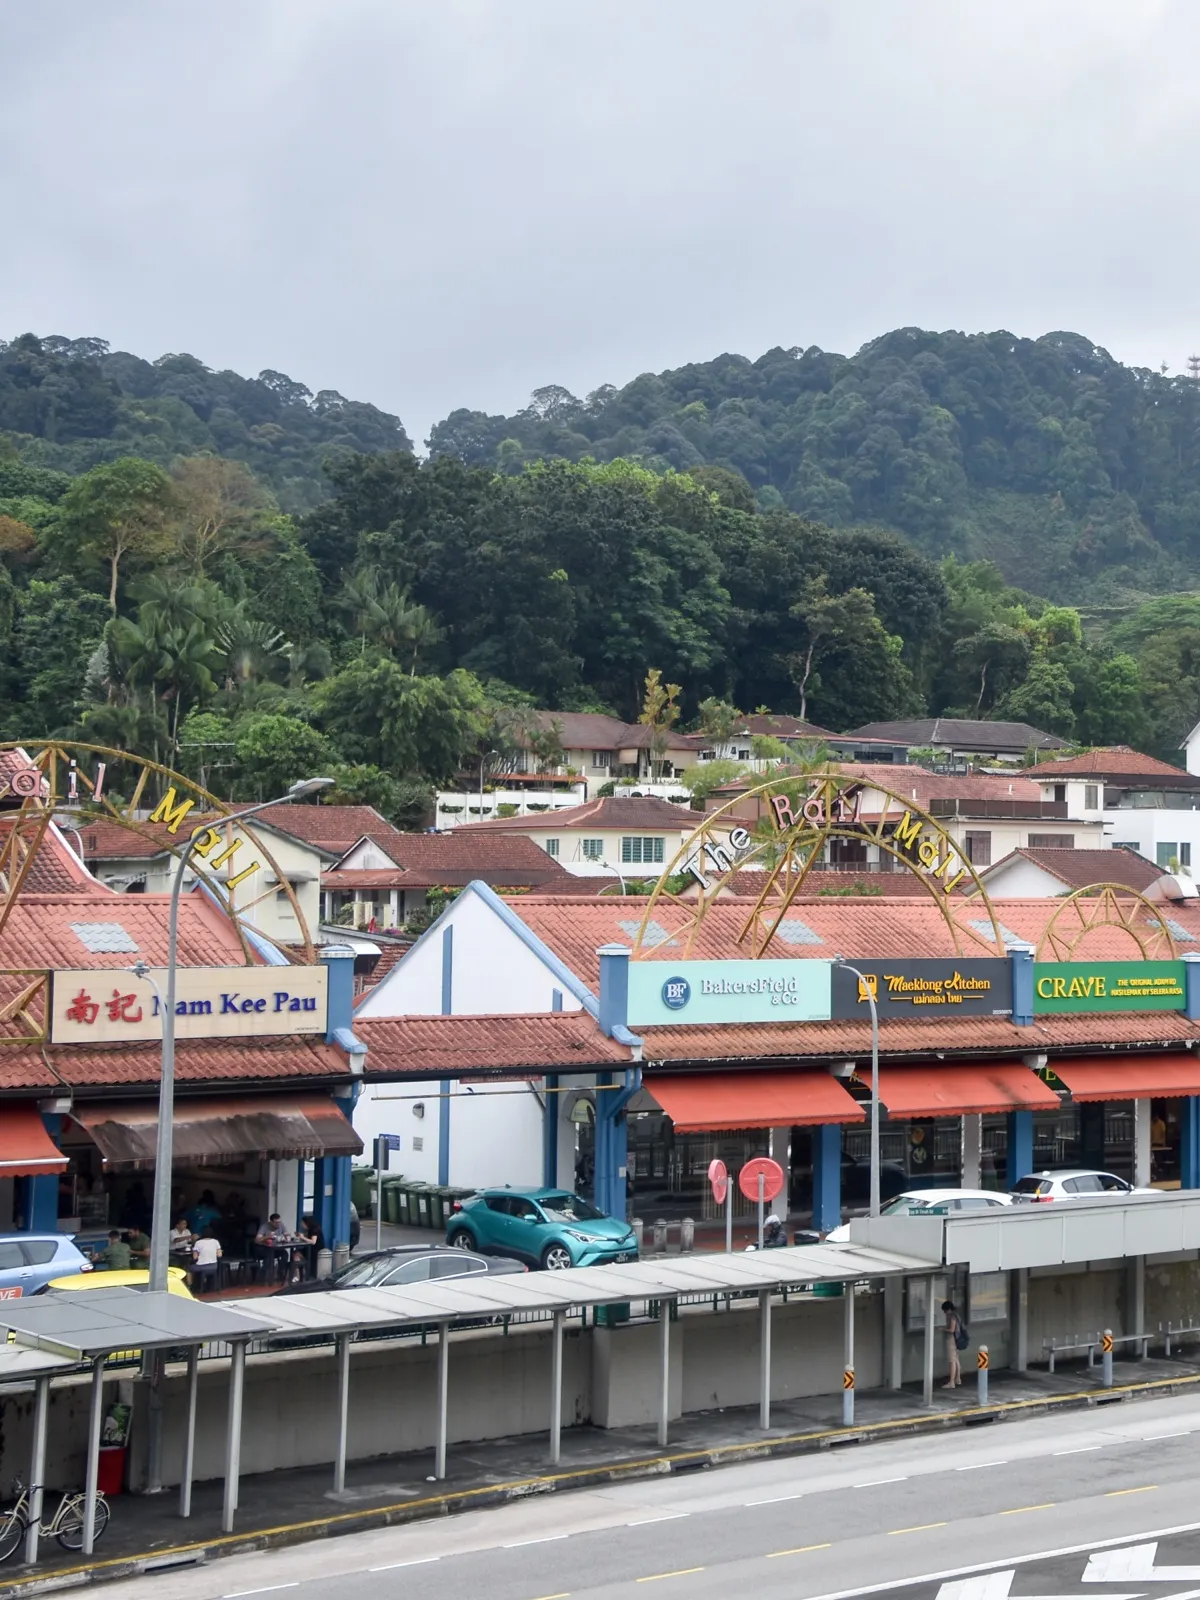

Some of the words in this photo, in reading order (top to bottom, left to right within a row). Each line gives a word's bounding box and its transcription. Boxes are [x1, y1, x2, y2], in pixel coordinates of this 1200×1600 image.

[149, 786, 261, 890] Mall
[681, 826, 751, 890] The
[771, 789, 862, 829] Rail
[892, 810, 967, 894] Mall
[667, 983, 687, 998] BF
[700, 976, 798, 995] BakersField
[883, 974, 943, 993] Maeklong
[943, 971, 991, 991] Kitchen
[1037, 977, 1107, 998] CRAVE
[66, 988, 144, 1025] 南記
[220, 993, 267, 1014] Kee
[273, 991, 317, 1012] Pau
[771, 997, 780, 1005] &
[782, 992, 799, 1004] Co
